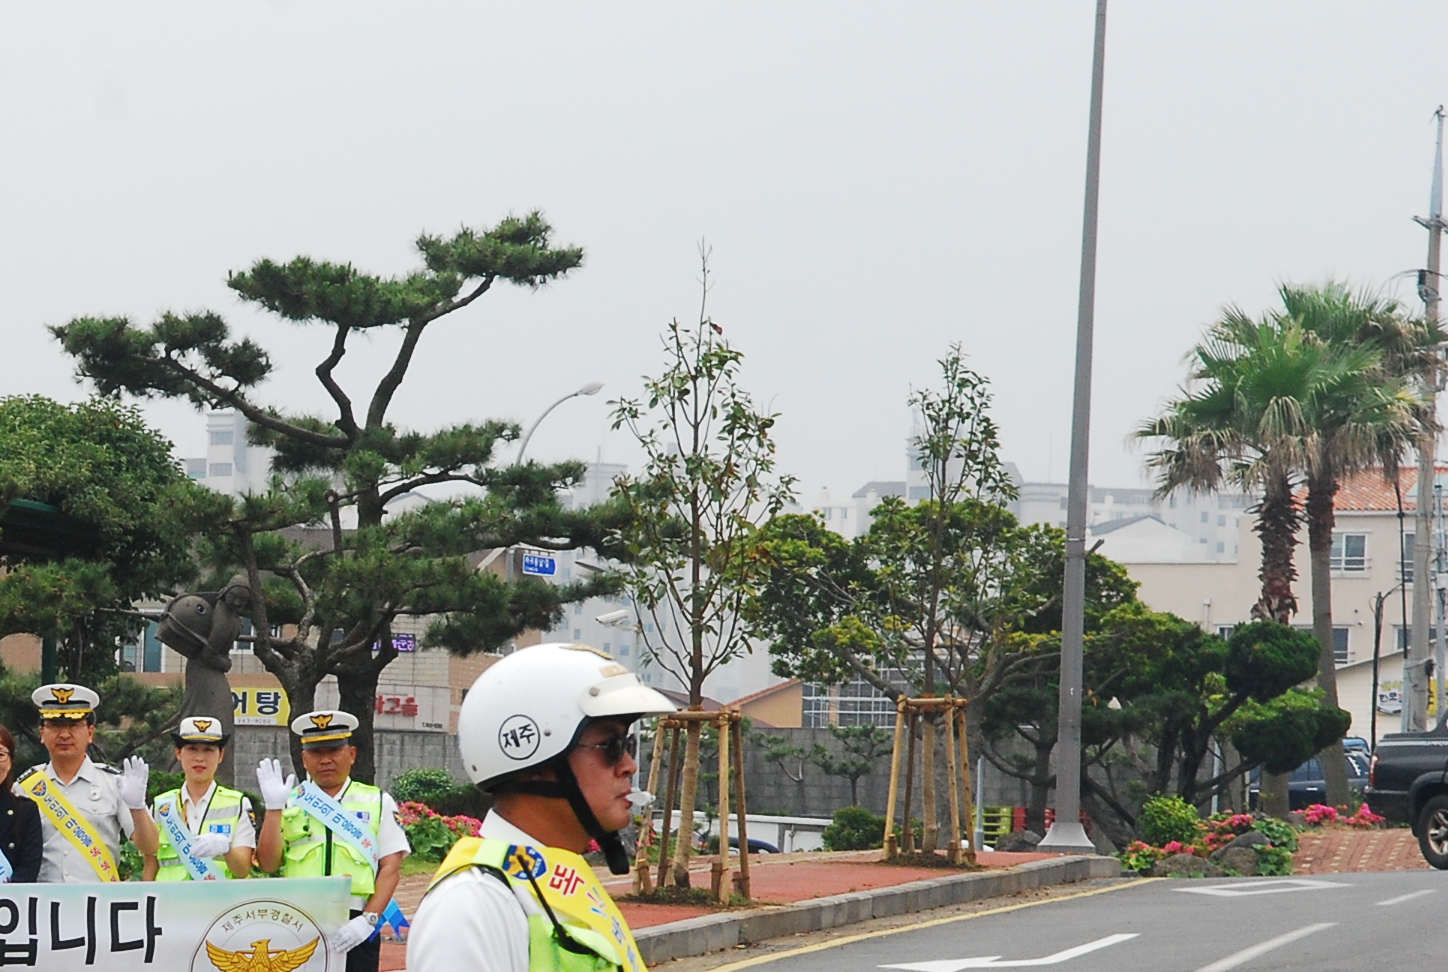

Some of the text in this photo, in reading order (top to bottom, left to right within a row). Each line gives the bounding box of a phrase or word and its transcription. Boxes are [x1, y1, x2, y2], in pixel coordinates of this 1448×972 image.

[502, 723, 536, 749] 제주
[44, 794, 69, 820] 도민의
[65, 817, 93, 847] 마음을
[166, 815, 186, 845] 도민의
[304, 793, 335, 817] 도민의
[332, 812, 363, 839] 마음을
[549, 864, 585, 896] 똑
[221, 908, 304, 933] 제주서부경찰서
